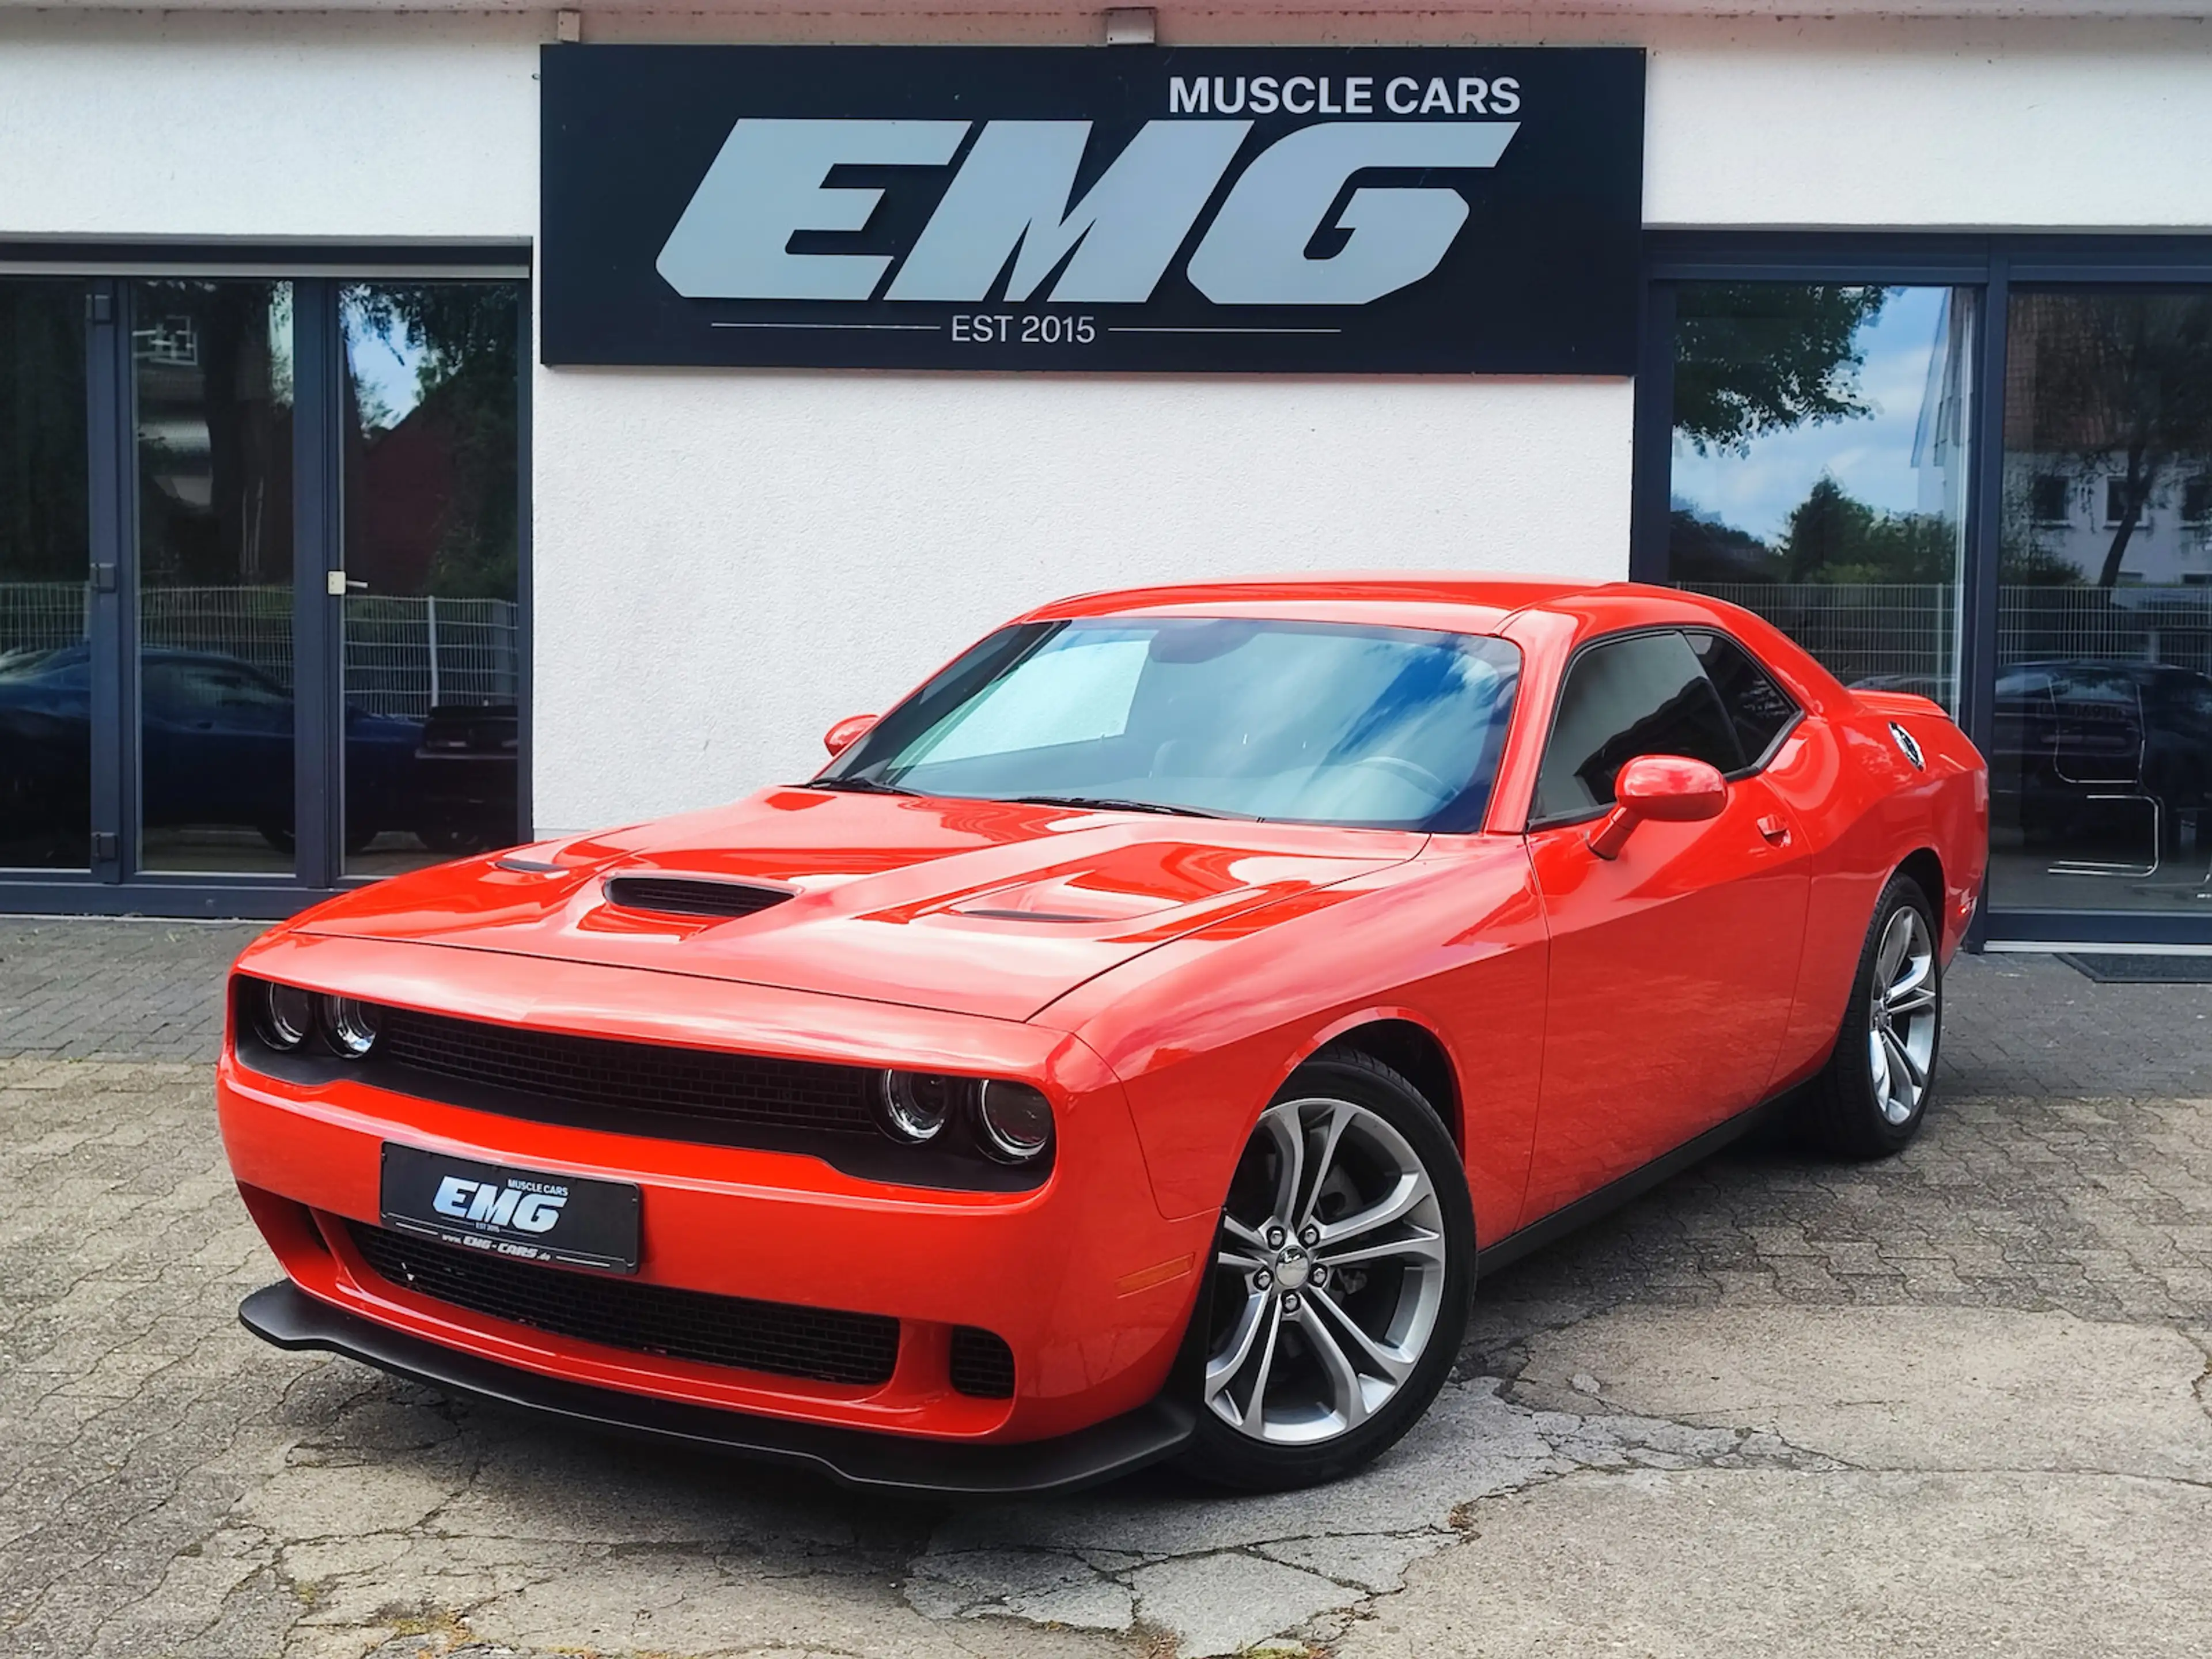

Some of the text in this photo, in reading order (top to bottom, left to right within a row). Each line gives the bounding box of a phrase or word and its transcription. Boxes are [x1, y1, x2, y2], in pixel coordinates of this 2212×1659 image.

[1169, 77, 1521, 115] MUSCLE CARS
[655, 118, 1522, 305] EMG
[952, 315, 1096, 343] EST 2015
[432, 1175, 568, 1233] EMG
[507, 1178, 569, 1196] MUSCLE CARS
